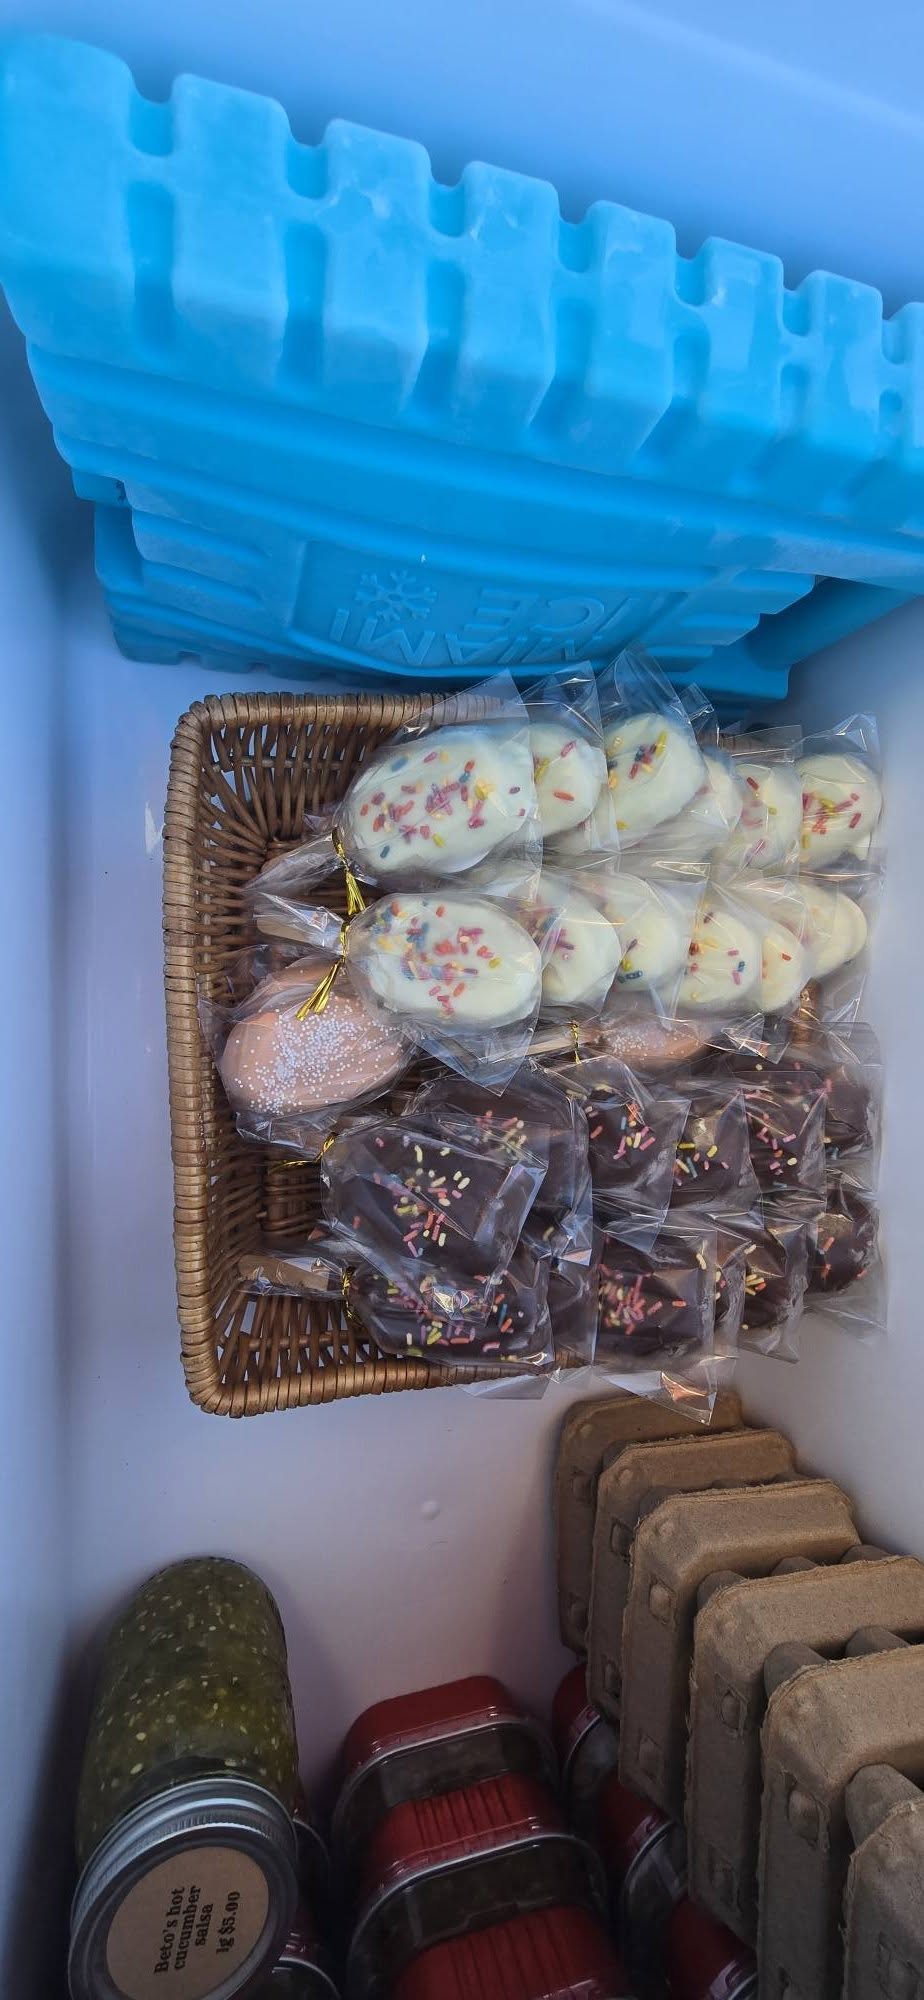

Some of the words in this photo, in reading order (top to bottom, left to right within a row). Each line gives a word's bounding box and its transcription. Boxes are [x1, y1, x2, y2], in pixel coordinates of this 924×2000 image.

[329, 608, 602, 665] MIAMI
[463, 589, 637, 641] ICE
[165, 1886, 185, 1917] hot
[174, 1885, 201, 1970] cucumber
[194, 1903, 214, 1946] salsa
[218, 1890, 240, 1935] $5.00
[153, 1919, 178, 1974] Beto's
